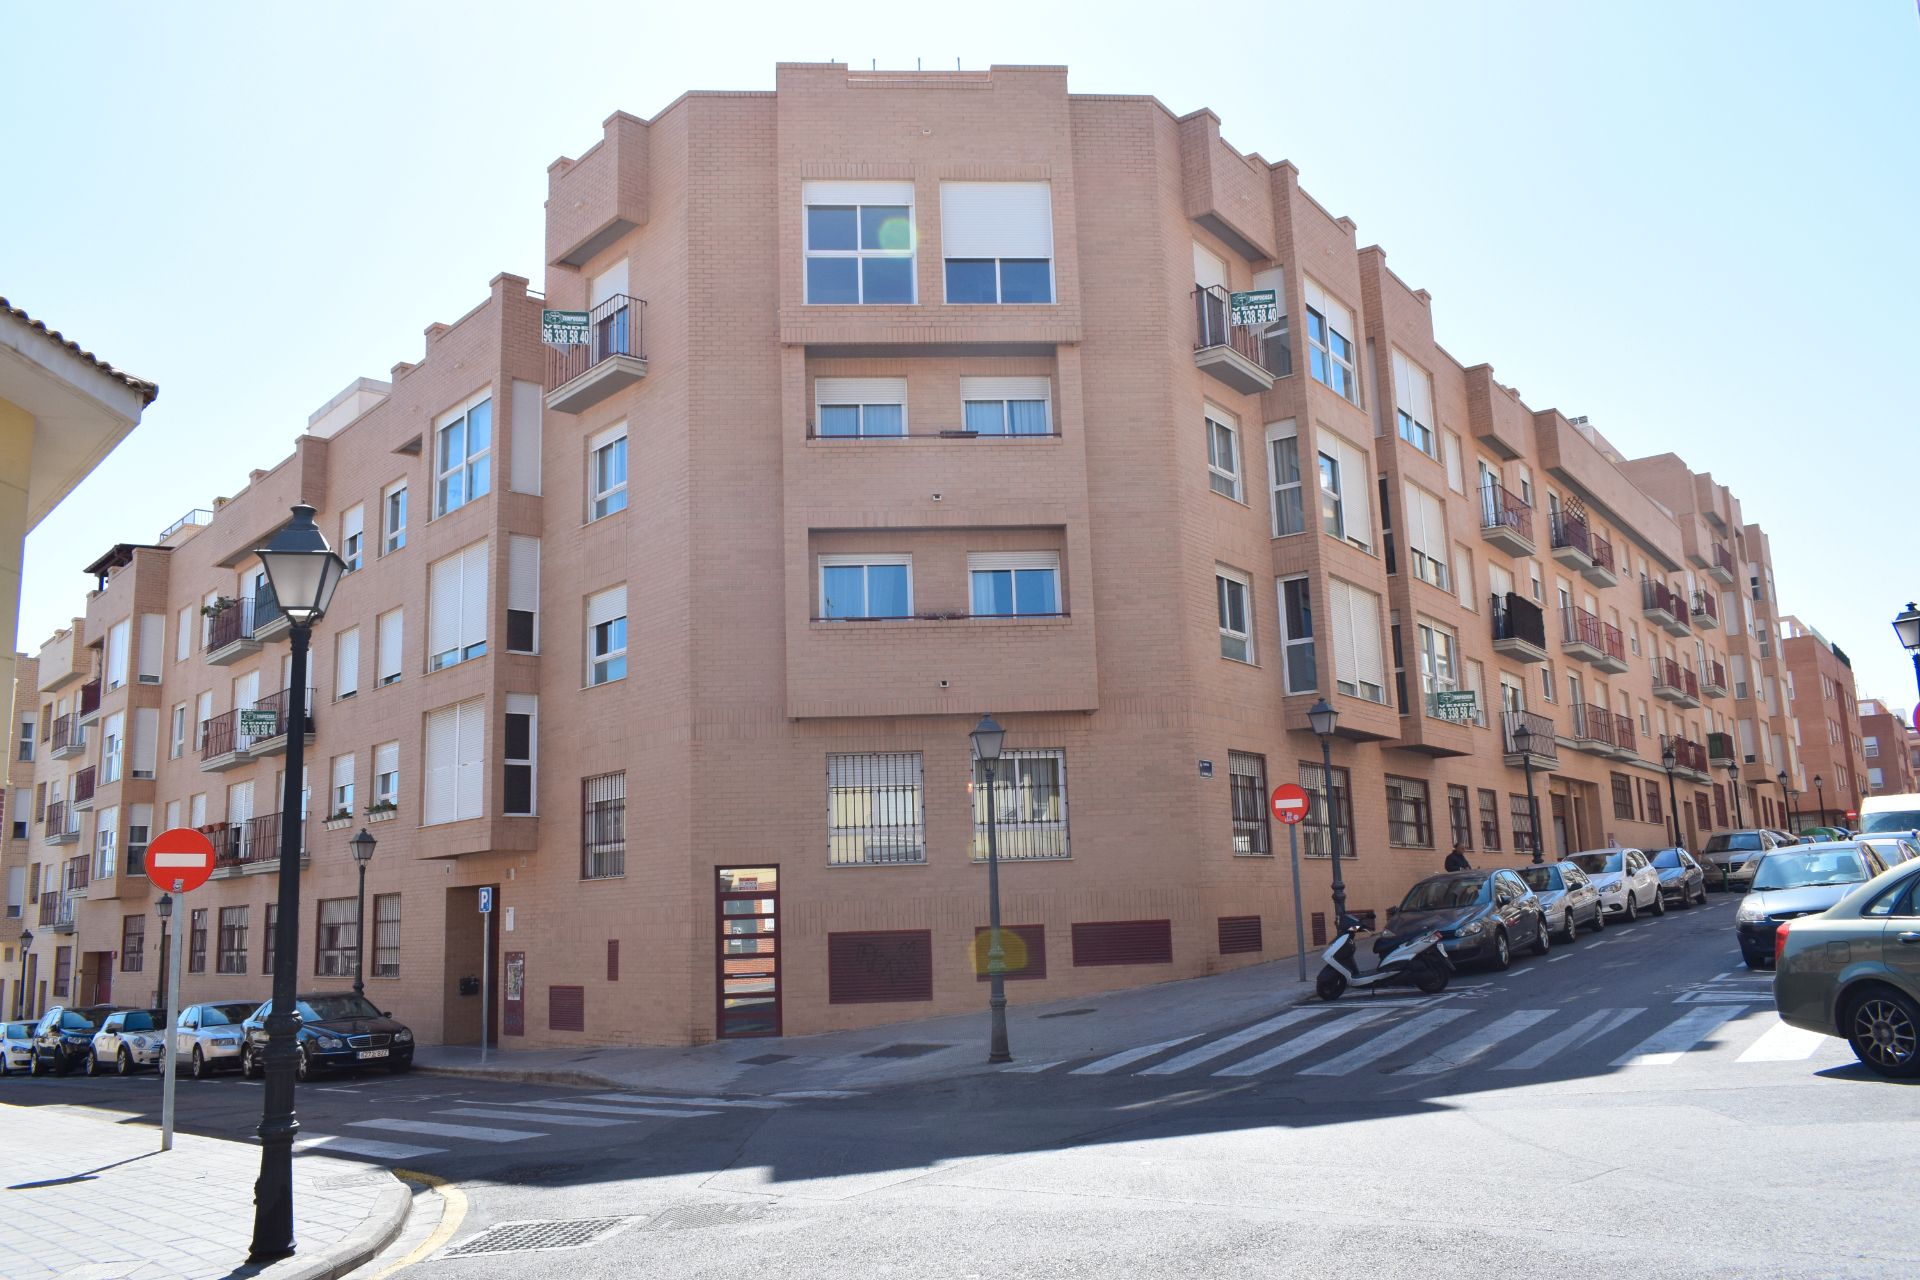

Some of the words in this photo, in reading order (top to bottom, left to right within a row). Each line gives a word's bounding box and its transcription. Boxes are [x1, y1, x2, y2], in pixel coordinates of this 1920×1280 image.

[1232, 311, 1241, 324] 96
[1243, 310, 1256, 324] 338
[1258, 309, 1266, 322] 58
[1268, 308, 1276, 321] 40
[544, 329, 552, 342] 96
[554, 329, 568, 343] 338
[570, 330, 578, 343] 58
[580, 331, 588, 344] 40
[1439, 708, 1446, 719] 96
[1448, 708, 1459, 719] 338
[1460, 707, 1468, 718] 58
[242, 725, 248, 734] 96
[250, 725, 260, 734] 338
[261, 725, 268, 734] 58
